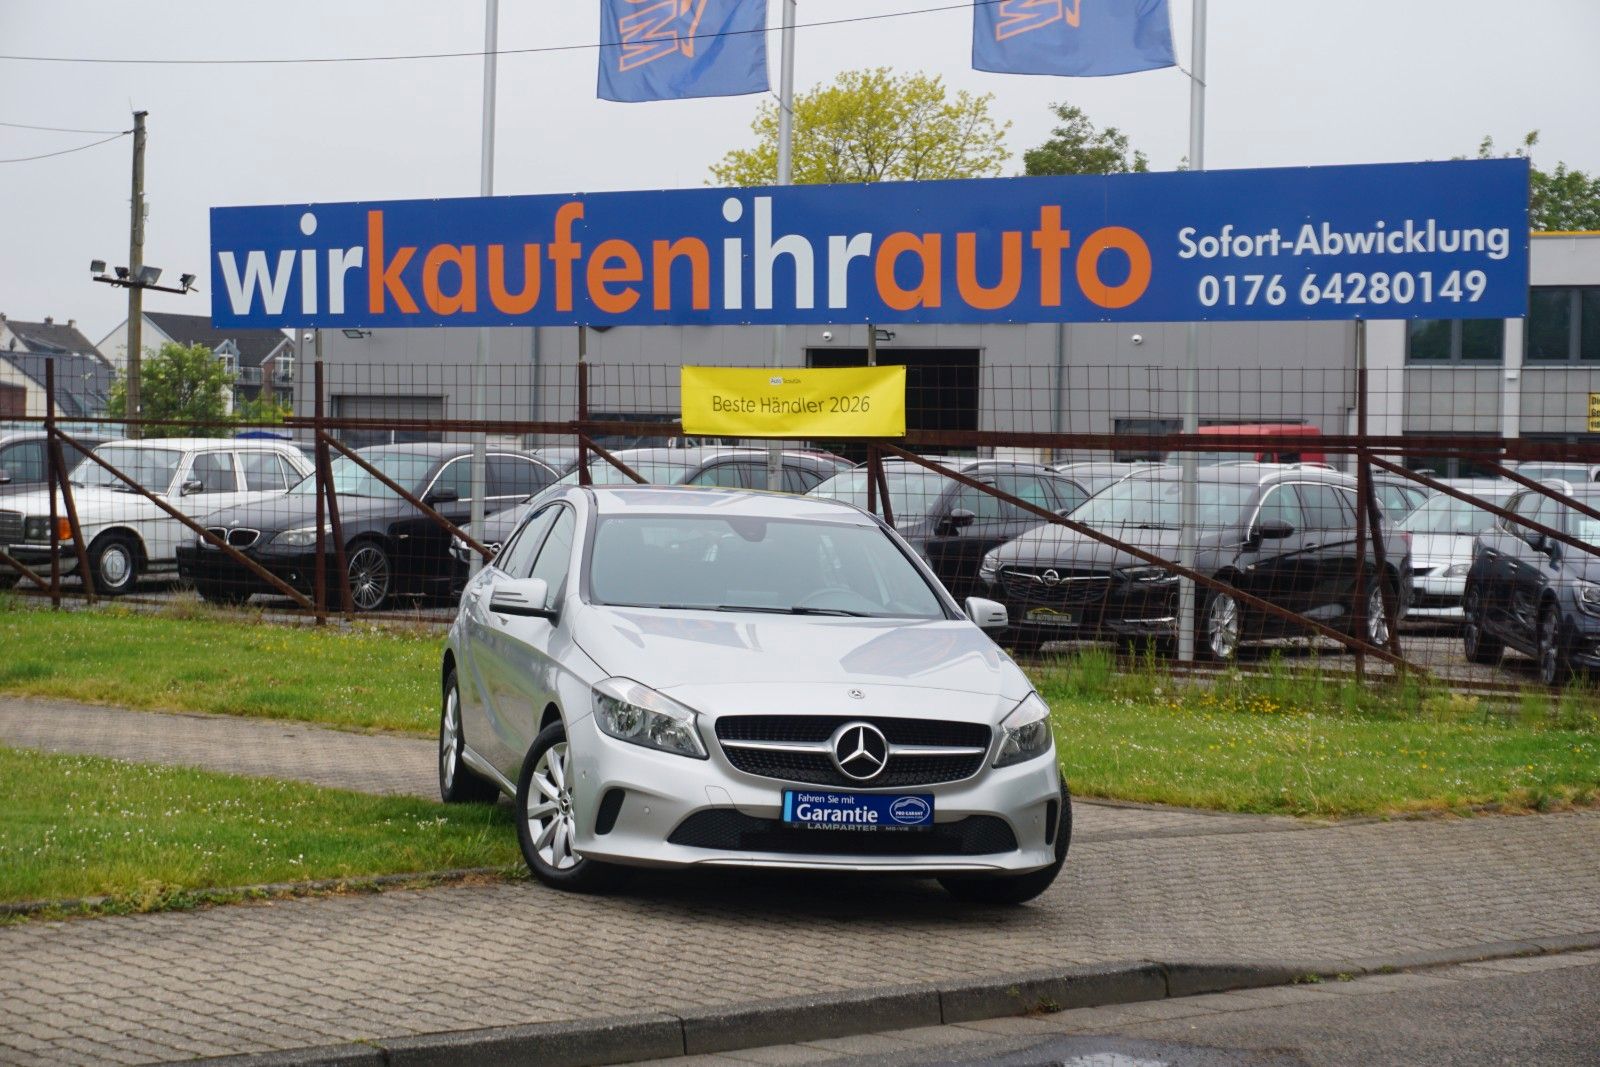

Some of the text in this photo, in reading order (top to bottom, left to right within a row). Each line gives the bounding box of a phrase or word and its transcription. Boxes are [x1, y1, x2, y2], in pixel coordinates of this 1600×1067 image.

[1178, 219, 1510, 260] Sofort-Abwicklung
[218, 197, 1152, 315] wirkaufenihrauto
[1199, 270, 1488, 307] 0176 64280149
[712, 395, 870, 414] Beste Händler 2026
[798, 793, 855, 804] Fahren Sie mit
[796, 803, 879, 823] Garantie
[807, 823, 877, 832] LAMPARTER
